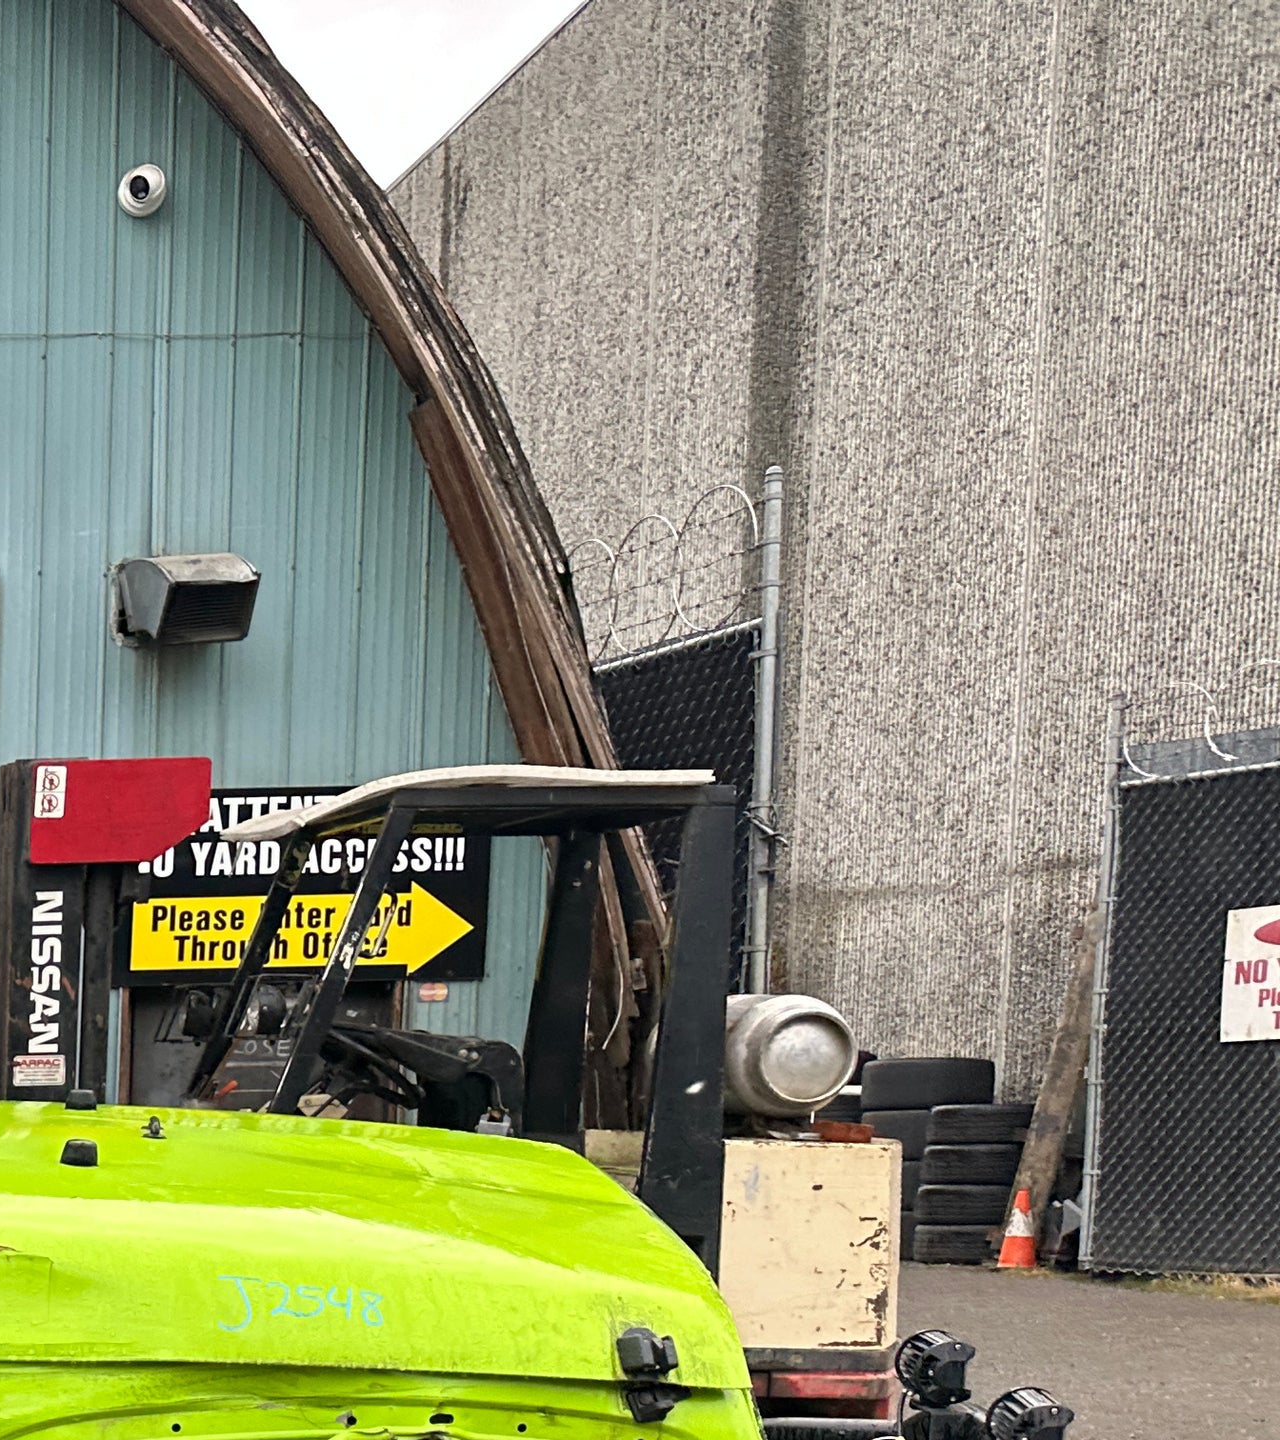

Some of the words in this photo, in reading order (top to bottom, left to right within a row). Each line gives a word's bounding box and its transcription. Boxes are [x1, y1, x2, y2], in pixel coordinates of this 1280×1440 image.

[191, 841, 281, 877] YARD
[302, 837, 466, 874] ACCSS!!!
[151, 905, 245, 933] Please
[260, 901, 336, 930] nter
[173, 934, 289, 966] Throh
[302, 931, 389, 960] Ofce
[28, 890, 64, 1054] NISSAN
[1234, 958, 1269, 985] NO
[216, 1273, 384, 1332] J2548
